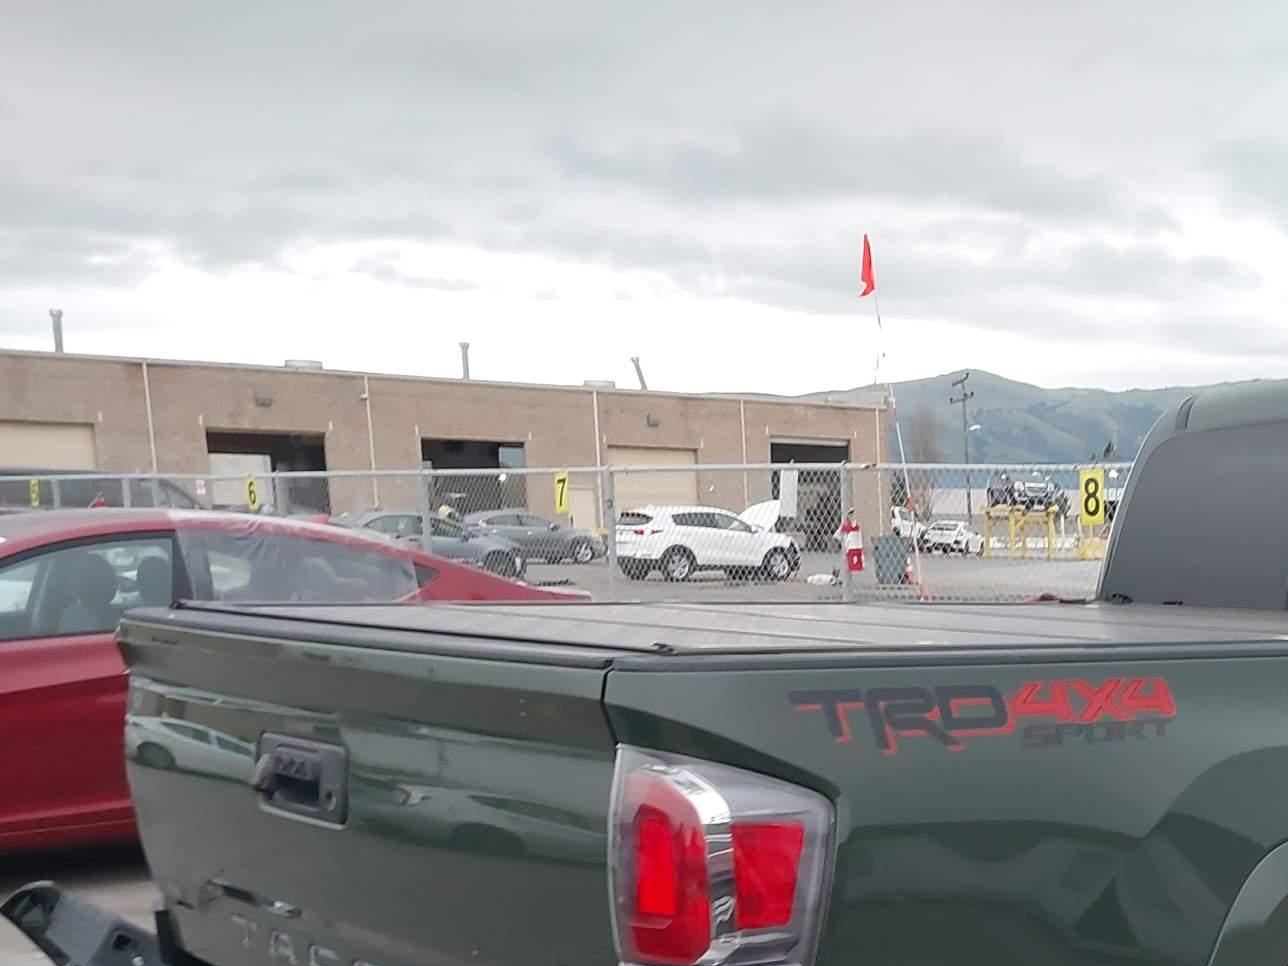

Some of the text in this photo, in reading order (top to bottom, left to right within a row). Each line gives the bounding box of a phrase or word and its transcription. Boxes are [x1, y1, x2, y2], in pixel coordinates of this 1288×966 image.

[248, 481, 257, 506] 6
[556, 478, 567, 507] 7
[1084, 477, 1100, 517] 8
[787, 683, 1017, 756] TRD
[1022, 716, 1178, 750] SPORT
